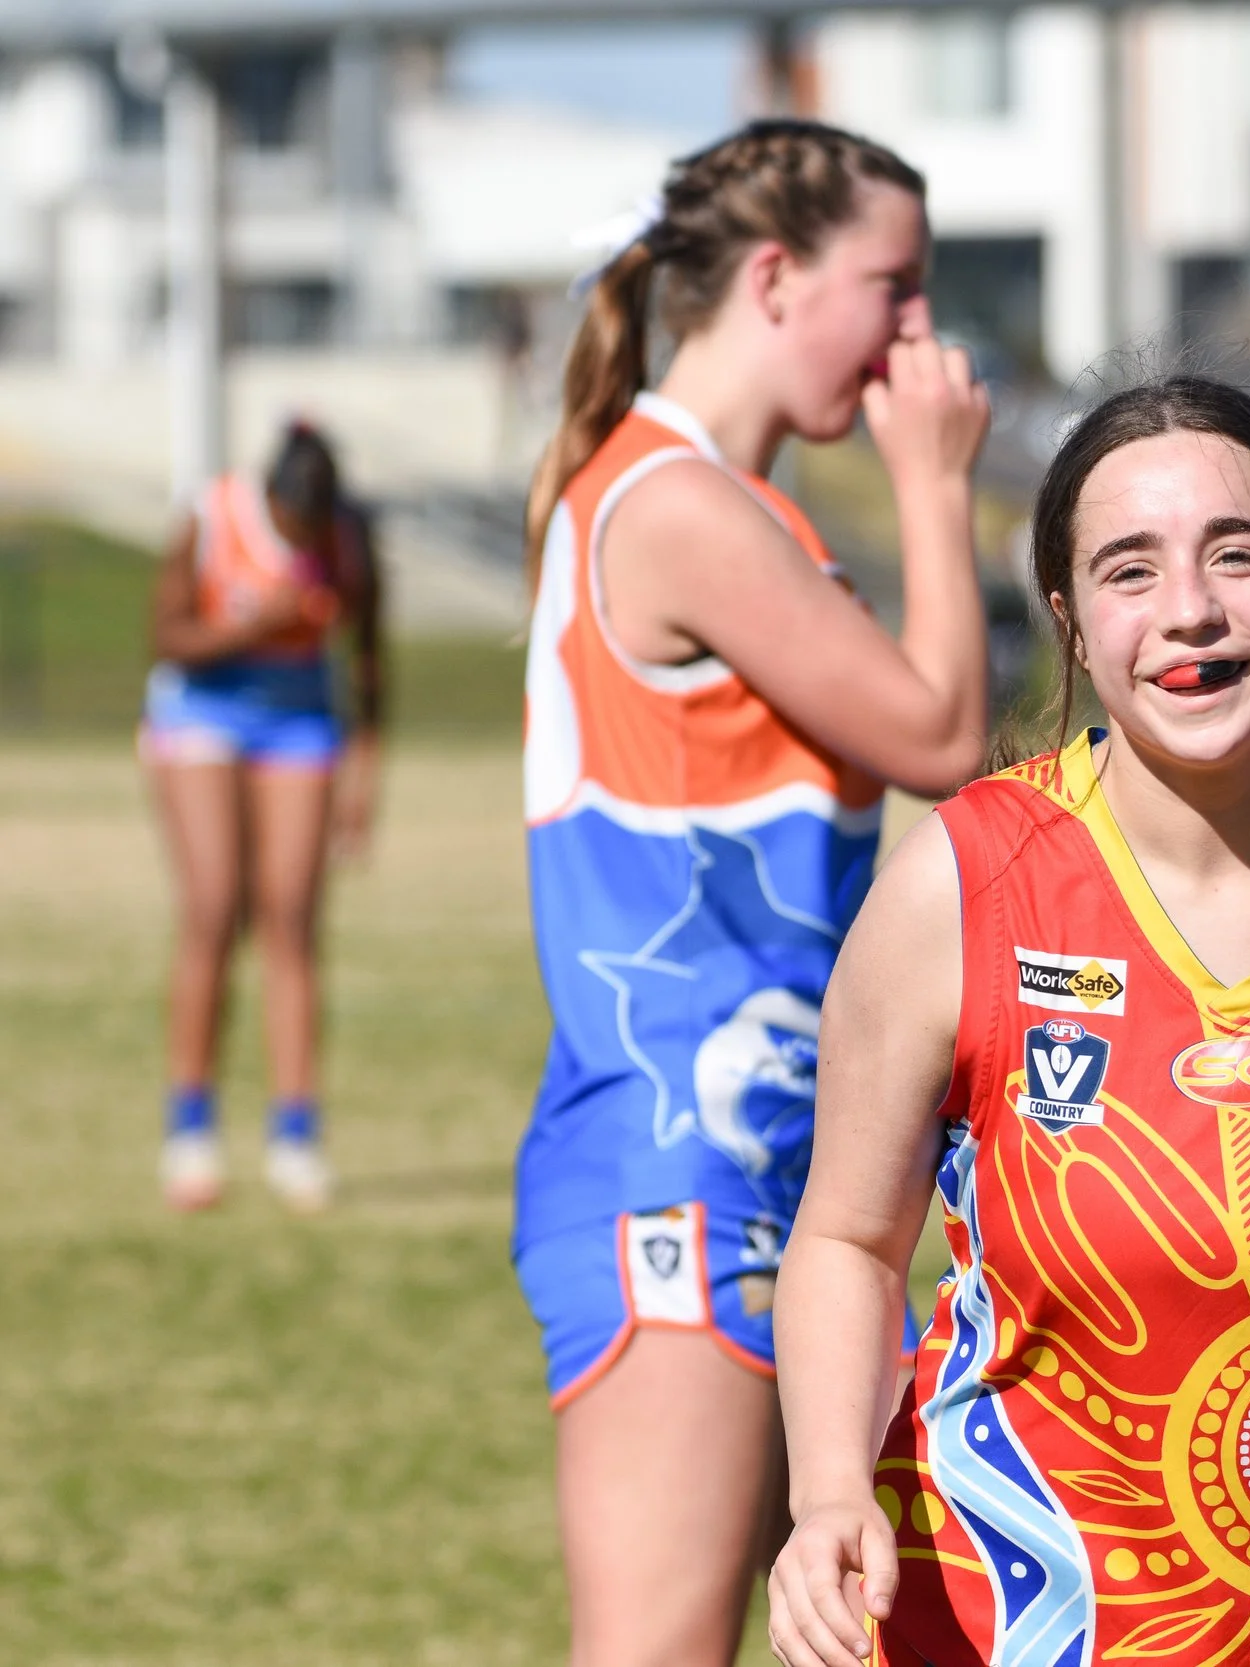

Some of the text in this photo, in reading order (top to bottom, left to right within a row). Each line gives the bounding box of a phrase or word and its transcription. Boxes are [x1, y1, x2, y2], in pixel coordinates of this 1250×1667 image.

[1046, 1023, 1082, 1041] AFL
[1032, 1048, 1094, 1101] V
[1029, 1101, 1085, 1120] COUNTRY
